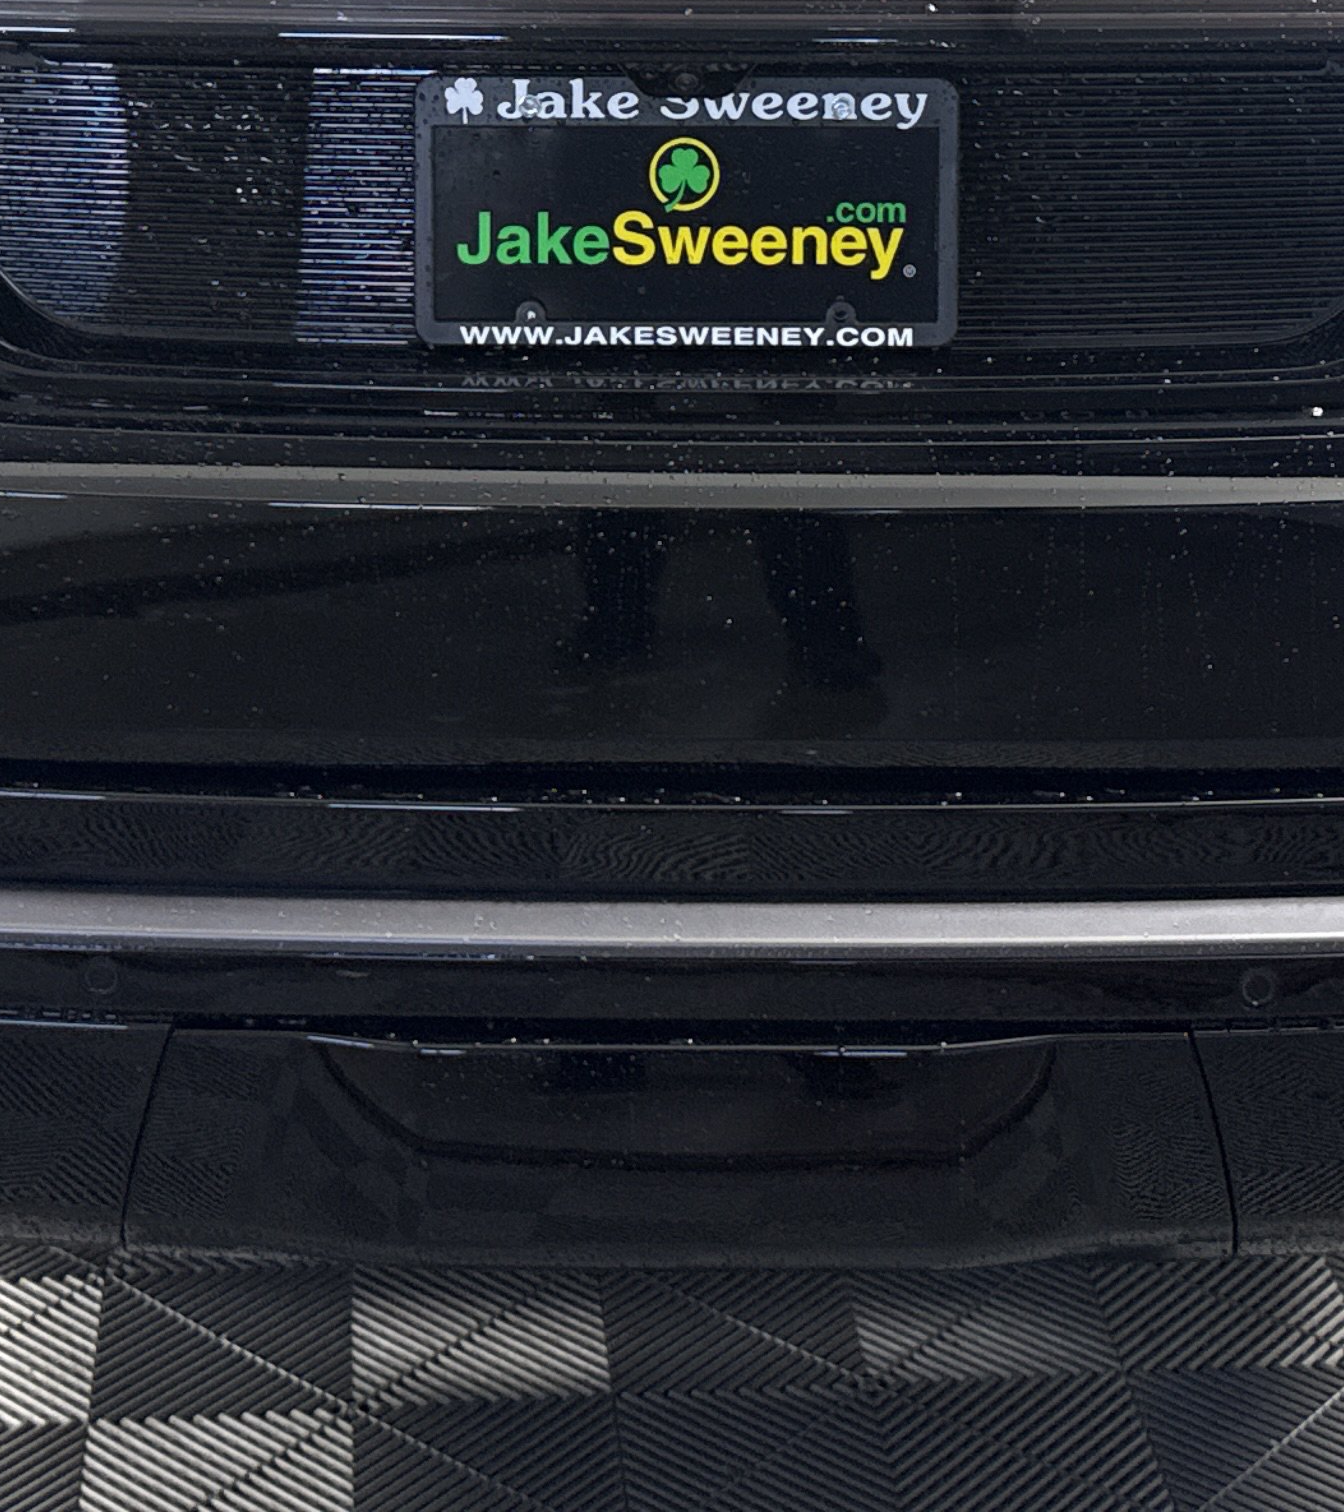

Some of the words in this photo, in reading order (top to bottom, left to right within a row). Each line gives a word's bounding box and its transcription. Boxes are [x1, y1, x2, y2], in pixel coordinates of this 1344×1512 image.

[496, 79, 640, 120] Jake
[826, 201, 906, 224] .com
[456, 209, 905, 280] JakeSweeney
[460, 326, 915, 347] WWW.JAKESWEENEY.COM
